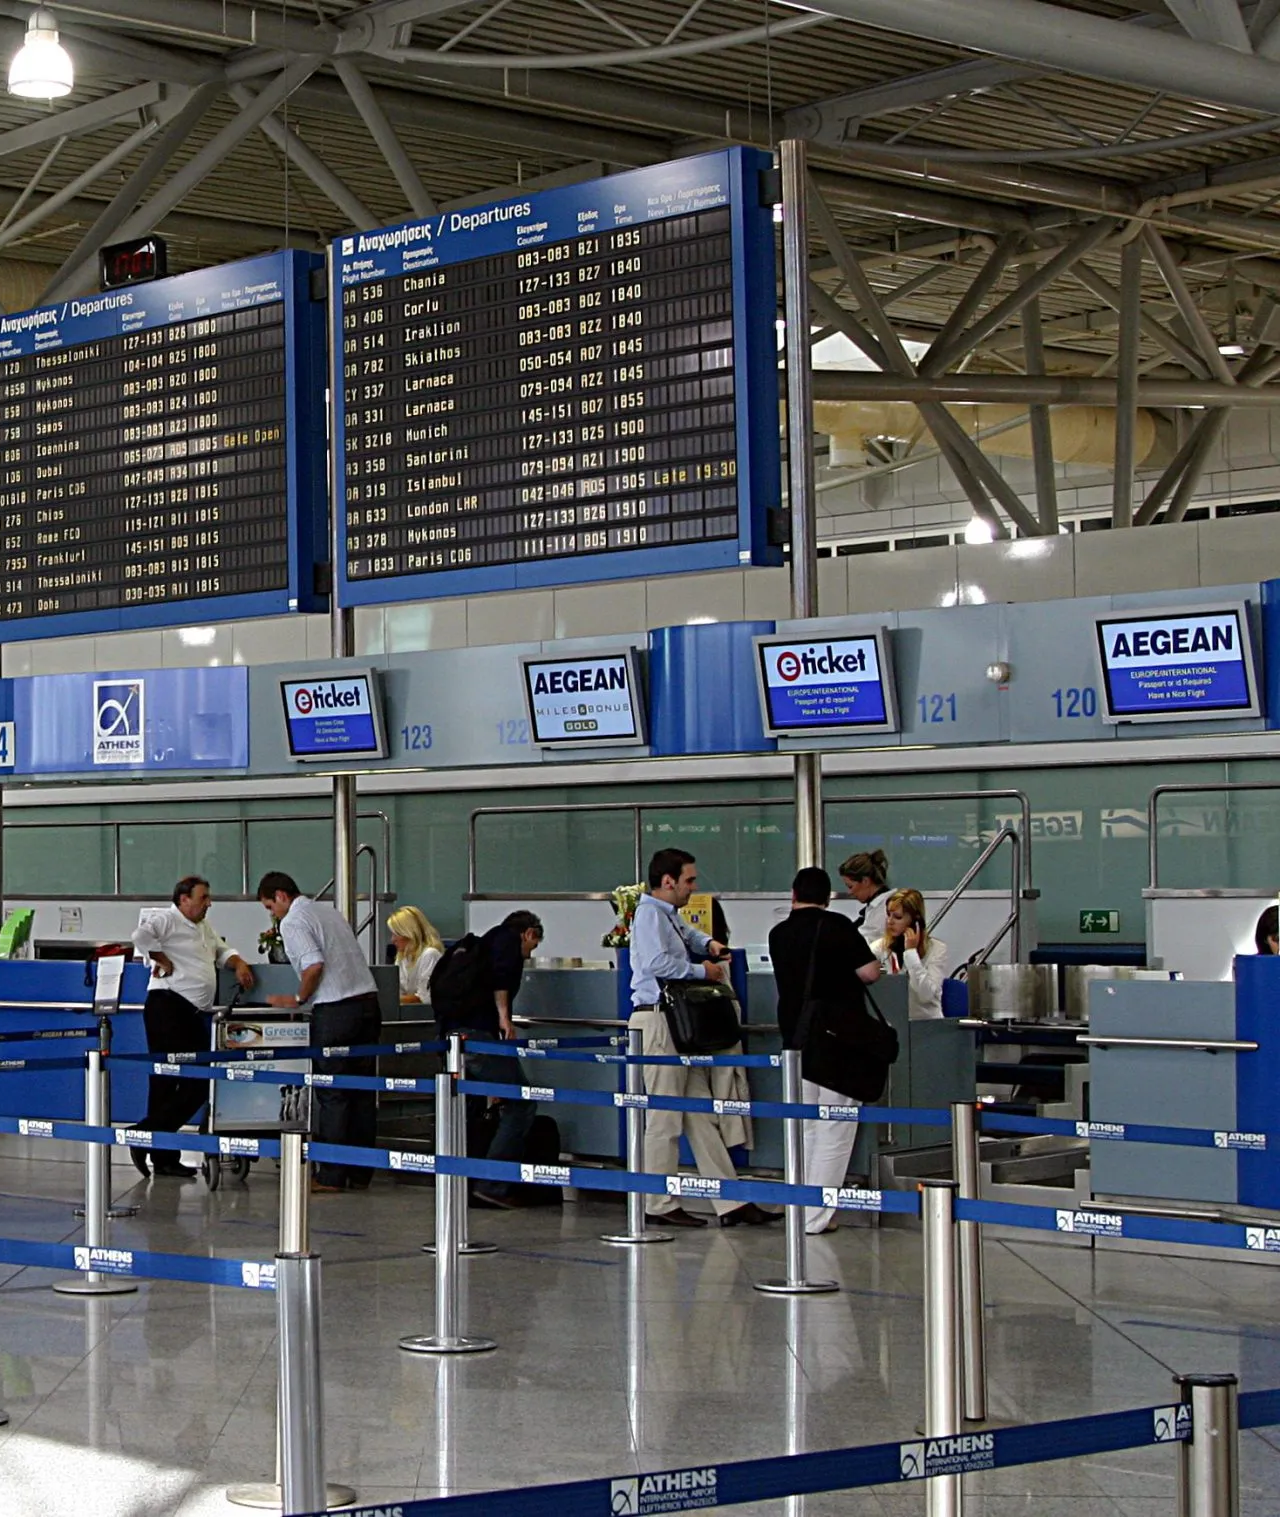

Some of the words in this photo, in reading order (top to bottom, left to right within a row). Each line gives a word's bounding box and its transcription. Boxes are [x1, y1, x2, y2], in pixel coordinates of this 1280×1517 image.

[451, 202, 531, 232] Departures
[615, 215, 632, 225] Time
[578, 223, 595, 233] Gate
[517, 234, 544, 246] Counter
[404, 273, 445, 292] Chania
[611, 230, 640, 249] 1835
[520, 271, 570, 294] 127-133
[611, 257, 640, 276] 1840
[72, 293, 133, 317] Departures
[405, 322, 460, 342] Iraklion
[612, 284, 641, 302] 1840
[613, 311, 642, 329] 1840
[37, 345, 99, 369] Thessaloniki
[193, 320, 216, 335] 1800
[36, 375, 73, 392] Mykonos
[194, 344, 216, 359] 1800
[406, 374, 454, 392] Larnaca
[520, 350, 571, 372] 050-054
[613, 338, 642, 355] 1845
[194, 390, 217, 406] 1800
[406, 399, 454, 417] Larnaca
[521, 377, 572, 398] 079-094
[614, 365, 643, 382] 1845
[36, 398, 73, 414] Mykonos
[406, 424, 447, 442] Munich
[522, 404, 571, 424] 145-151
[614, 392, 643, 409] 1855
[37, 440, 79, 456] Ioannina
[37, 464, 62, 478] Dubai
[195, 437, 217, 451] 1805
[255, 427, 279, 442] Open
[407, 446, 468, 467] Santorini
[523, 430, 573, 450] 127-133
[615, 419, 644, 436] 1900
[408, 472, 461, 492] Istanbul
[522, 456, 573, 476] 079-094
[615, 446, 644, 463] 1900
[37, 487, 63, 500] Paris
[195, 461, 217, 475] 1810
[408, 502, 448, 517] London
[457, 496, 477, 511] LHR
[523, 483, 574, 502] 042-046
[616, 474, 645, 490] 1905
[654, 469, 686, 484] Late
[697, 461, 736, 480] 19:30
[37, 510, 64, 522] Chios
[195, 484, 218, 498] 1815
[408, 526, 456, 544] Mykonos
[524, 509, 574, 528] 127-133
[617, 501, 646, 517] 1910
[196, 531, 218, 545] 1815
[409, 553, 442, 568] Paris
[525, 535, 575, 554] 111-114
[617, 528, 646, 544] 1910
[38, 570, 102, 589] Thessaloniki
[38, 599, 59, 611] Doha
[196, 578, 219, 592] 1815
[1112, 625, 1233, 658] AEGEAN
[534, 666, 625, 694] AEGEAN
[1139, 680, 1166, 688] Passport
[1183, 677, 1212, 686] Required
[918, 692, 956, 723] 121
[1052, 687, 1096, 718] 120
[497, 719, 528, 744] 122
[566, 721, 596, 730] GOLD
[98, 741, 139, 749] ATHENS
[401, 725, 432, 750] 123
[264, 1027, 308, 1036] Greece
[723, 1100, 751, 1108] ATHENS
[830, 1106, 859, 1114] ATHENS
[28, 1121, 53, 1131] ATHENS
[126, 1130, 152, 1139] ATHENS
[1089, 1123, 1124, 1133] ATHENS
[230, 1138, 259, 1147] ATHENS
[1228, 1133, 1265, 1142] ATHENS
[402, 1153, 435, 1164] ATHENS
[534, 1165, 569, 1175] ATHENS
[681, 1177, 720, 1188] ATHENS
[838, 1188, 881, 1200] ATHENS
[1075, 1212, 1122, 1226] ATHENS
[90, 1248, 132, 1262] ATHENS
[926, 1434, 993, 1457] ATHENS
[640, 1469, 717, 1494] ATHENS
[640, 1491, 688, 1503] INTERNATIONAL
[691, 1487, 716, 1498] AIRPORT
